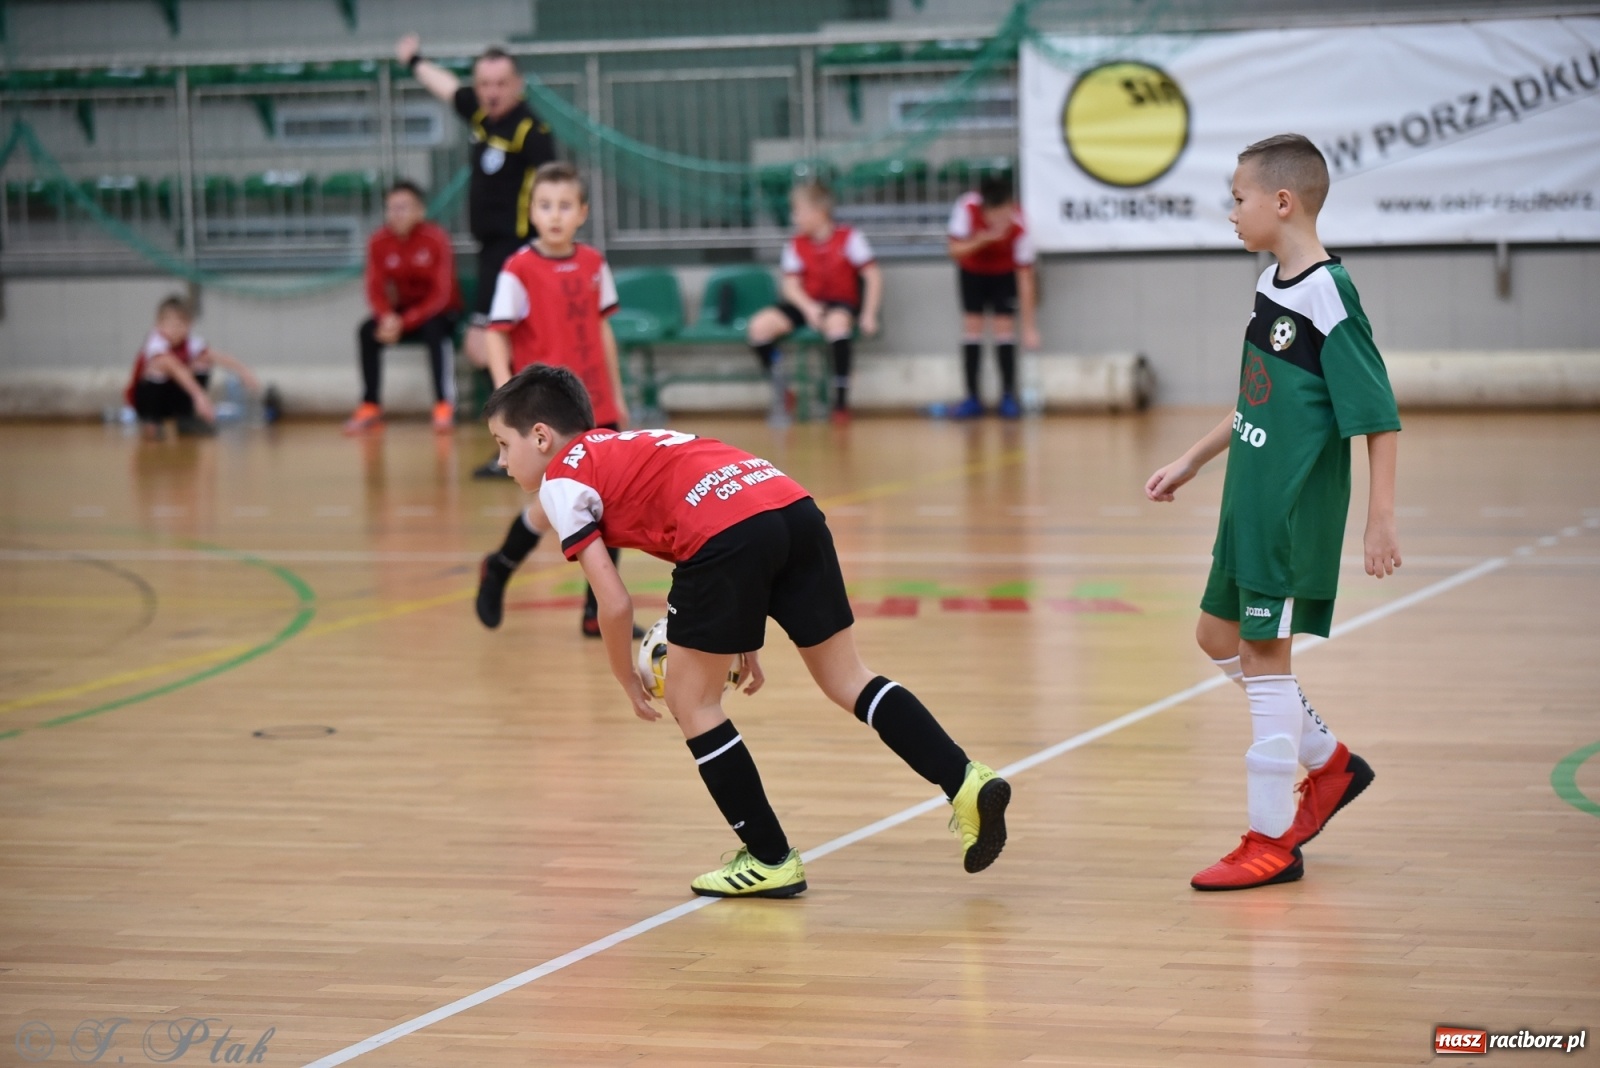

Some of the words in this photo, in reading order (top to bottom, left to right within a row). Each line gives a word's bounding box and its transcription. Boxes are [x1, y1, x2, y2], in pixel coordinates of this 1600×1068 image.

[1324, 131, 1361, 172] W
[1373, 51, 1600, 156] PORZĄDKU
[562, 443, 587, 469] AP
[715, 478, 743, 501] COŚ
